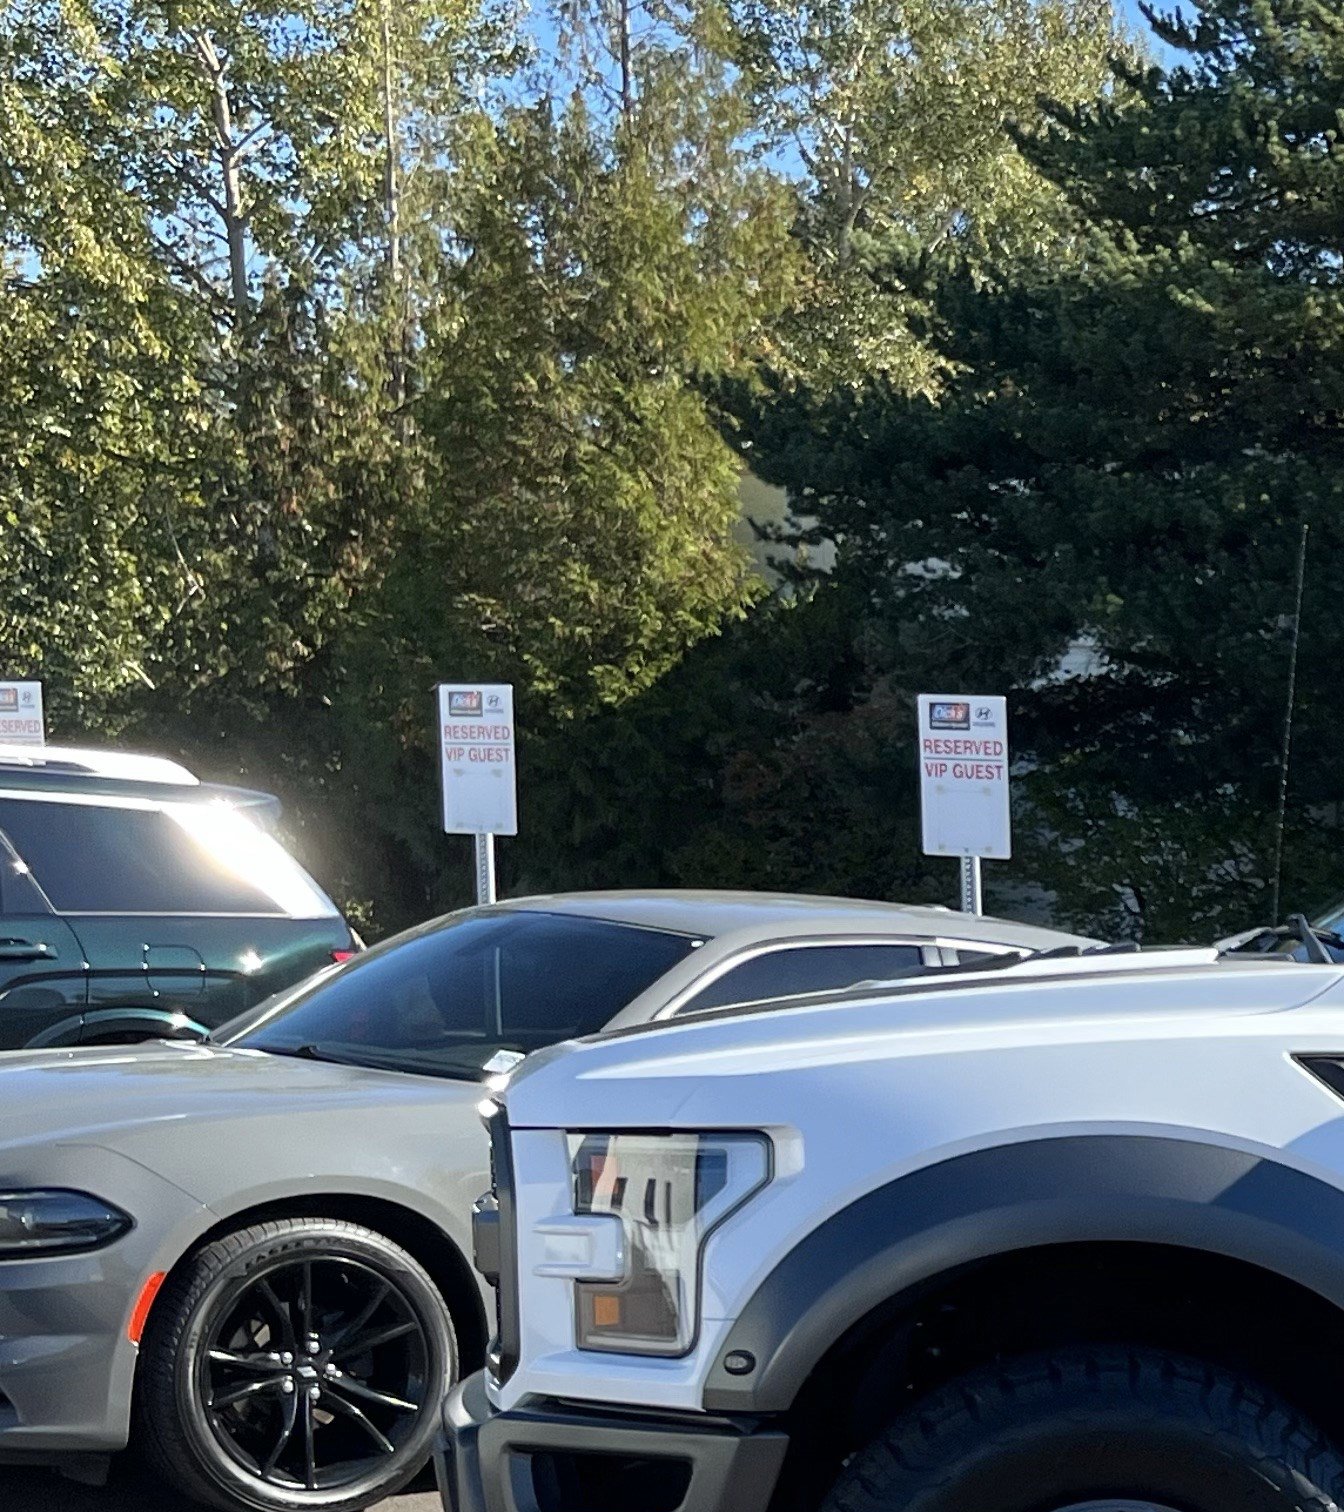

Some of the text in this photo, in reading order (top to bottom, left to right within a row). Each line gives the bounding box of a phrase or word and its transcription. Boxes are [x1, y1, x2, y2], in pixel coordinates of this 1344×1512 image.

[444, 725, 511, 740] RESERVED
[445, 749, 511, 763] VIP GUEST
[923, 739, 1004, 757] RESERVED
[925, 763, 1004, 781] VIP GUEST
